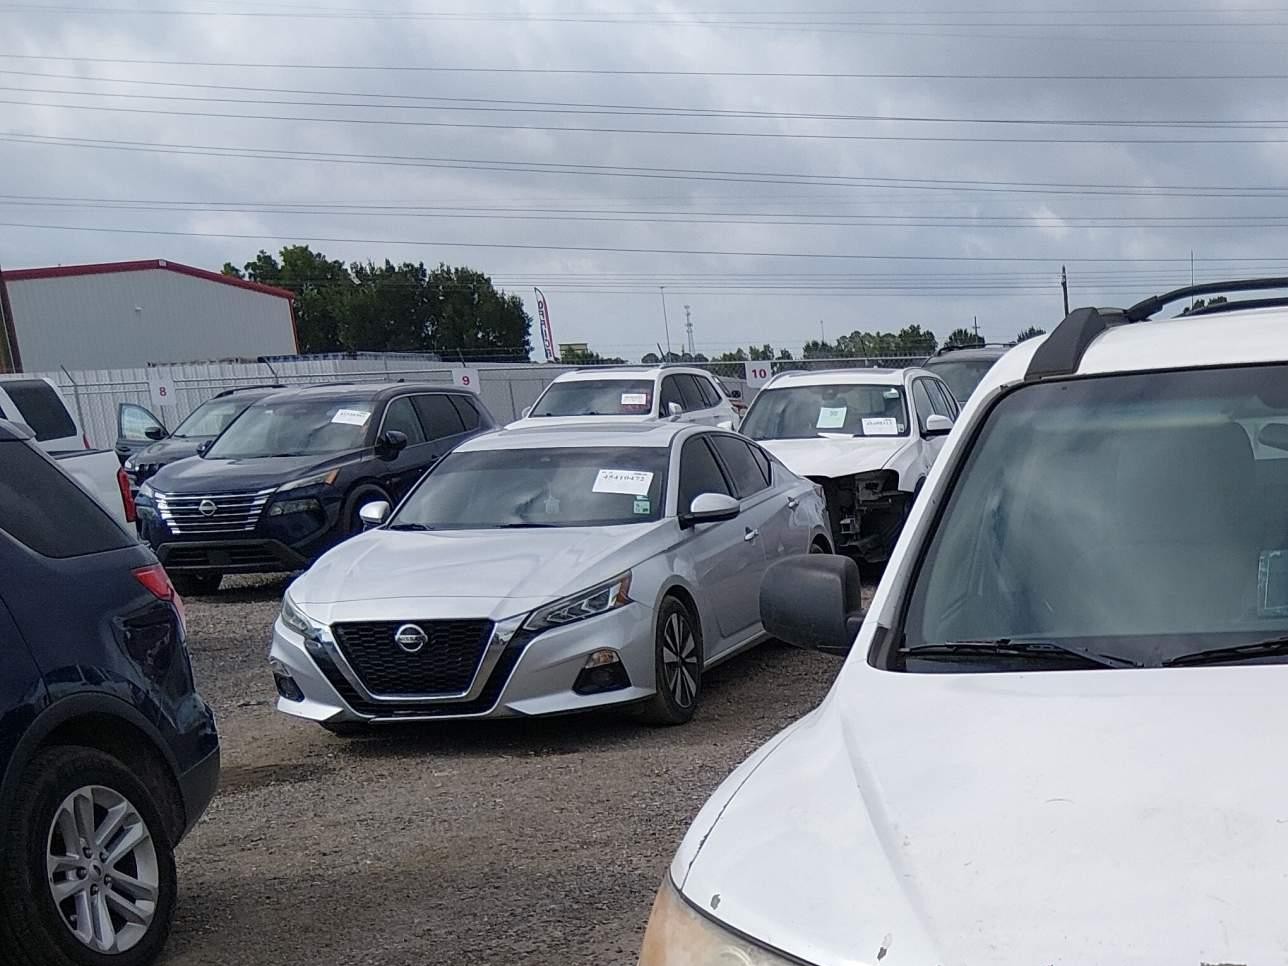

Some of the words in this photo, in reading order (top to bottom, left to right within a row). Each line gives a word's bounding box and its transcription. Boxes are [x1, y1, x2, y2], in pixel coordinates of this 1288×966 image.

[751, 369, 767, 379] 10
[462, 375, 470, 386] 9
[159, 386, 167, 397] 8
